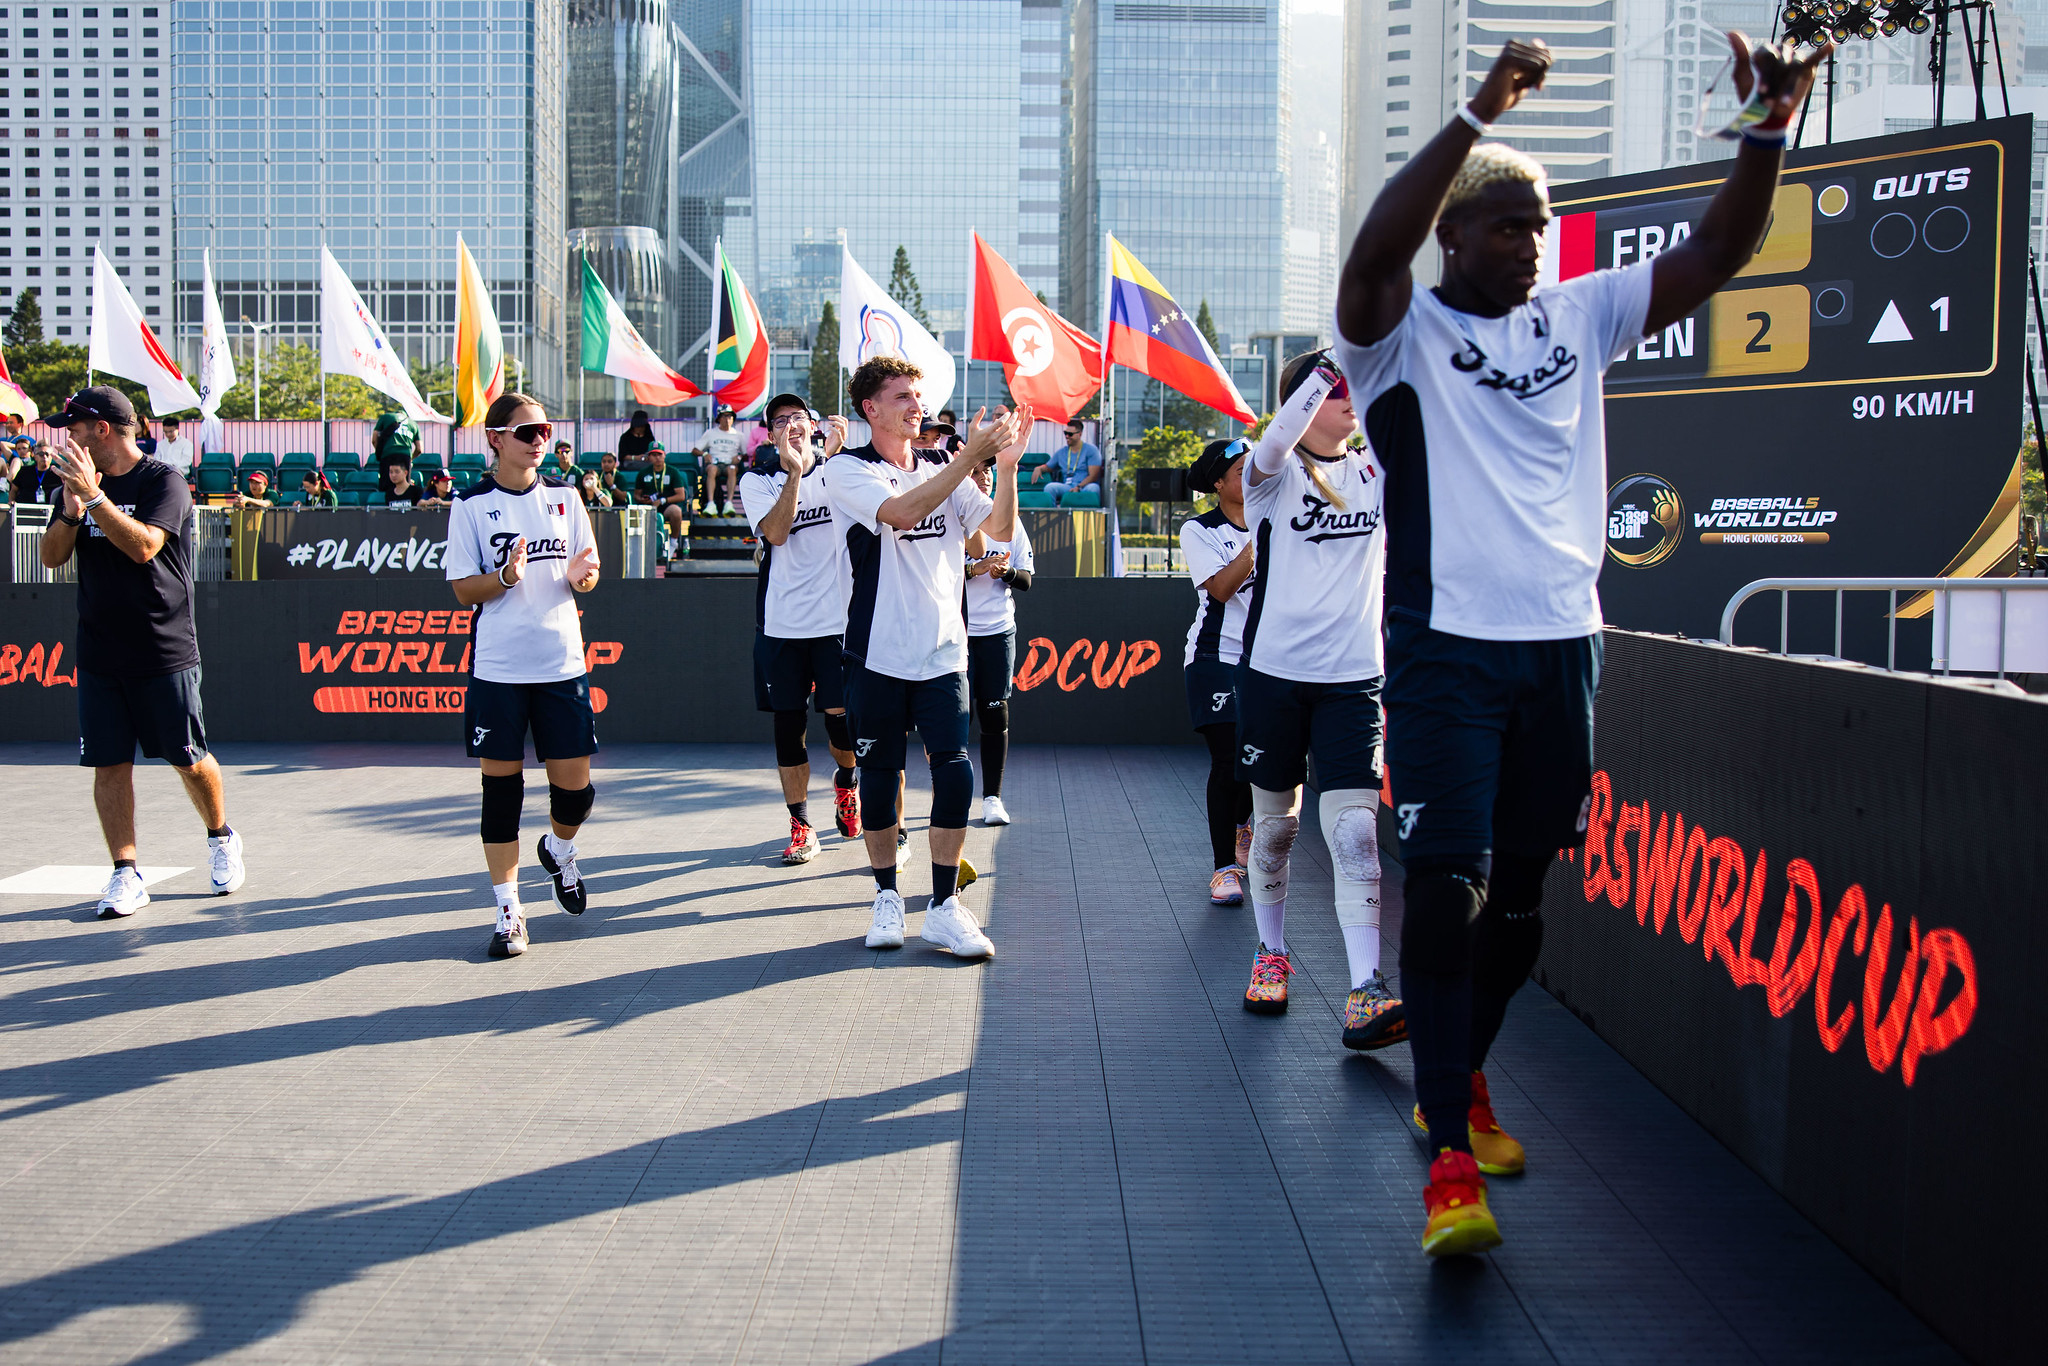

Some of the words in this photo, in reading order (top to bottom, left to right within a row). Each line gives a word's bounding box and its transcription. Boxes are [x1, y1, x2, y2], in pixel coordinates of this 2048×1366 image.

[1872, 167, 1972, 201] OUTS
[1612, 221, 1692, 268] FRA
[1929, 296, 1950, 332] 1
[1745, 311, 1773, 354] 2
[1301, 388, 1322, 414] ALLSIX
[1852, 395, 1886, 420] 90
[1895, 390, 1975, 417] KM/H
[1694, 511, 1782, 528] WORLD
[1782, 510, 1839, 527] CUP
[1710, 497, 1820, 511] BASEBALL5
[490, 532, 567, 568] Fance
[1722, 534, 1751, 544] HONG
[1751, 534, 1779, 544] KONG
[1780, 533, 1805, 543] 2024
[336, 610, 475, 635] BASEB
[298, 642, 473, 673] WORL
[1012, 636, 1162, 692] DCUP
[368, 691, 429, 709] HONG
[435, 691, 468, 709] KO
[1580, 769, 1978, 1088] B5WORLDCUP
